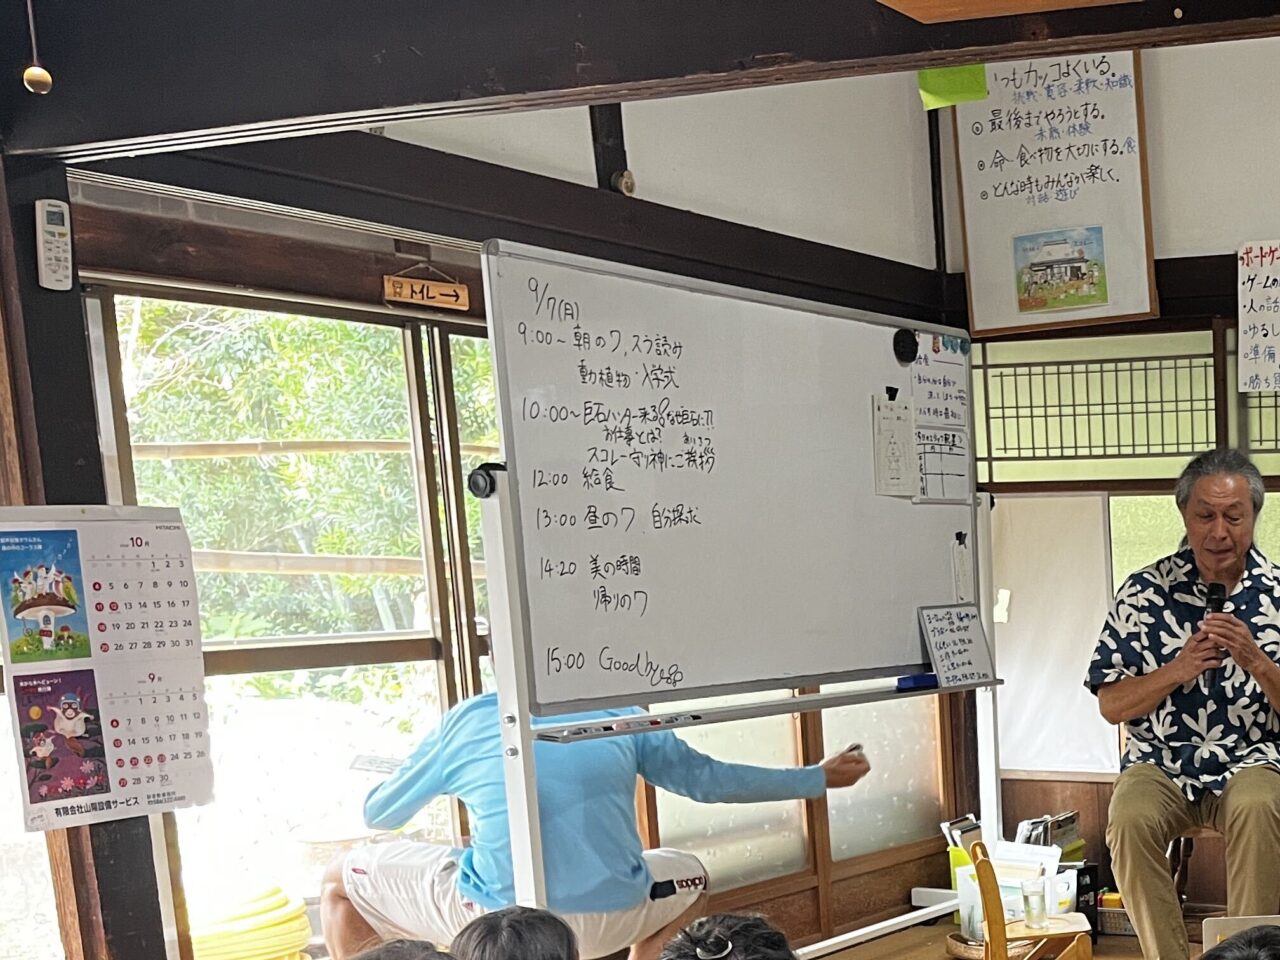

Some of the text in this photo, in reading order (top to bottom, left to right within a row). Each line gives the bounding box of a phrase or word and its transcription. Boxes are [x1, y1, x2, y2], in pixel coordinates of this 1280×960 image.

[410, 283, 437, 301] トイレ
[533, 467, 625, 491] 12:00 給食
[536, 506, 577, 530] 13:00
[179, 560, 185, 568] 3
[540, 554, 641, 579] 14:20 美の時間
[108, 582, 114, 590] 5
[123, 582, 129, 590] 6
[138, 581, 144, 589] 7
[152, 581, 159, 589] 8
[167, 580, 173, 588] 9
[180, 580, 189, 588] 10
[124, 602, 133, 610] 13
[139, 601, 148, 609] 14
[153, 601, 161, 609] 15
[167, 600, 176, 608] 16
[126, 622, 136, 630] 20
[141, 621, 149, 629] 21
[154, 621, 164, 629] 22
[169, 620, 178, 628] 23
[183, 619, 192, 627] 24
[114, 643, 124, 651] 26
[128, 642, 138, 650] 27
[142, 641, 152, 649] 28
[156, 640, 166, 648] 29
[171, 640, 180, 648] 30
[185, 639, 194, 647] 31
[547, 647, 585, 675] 15:00
[152, 696, 157, 704] 2
[166, 695, 171, 703] 3
[179, 694, 185, 702] 4
[192, 693, 198, 701] 5
[127, 718, 132, 726] 7
[141, 717, 146, 725] 8
[154, 715, 160, 723] 9
[166, 714, 175, 722] 10
[180, 713, 188, 721] 11
[193, 712, 201, 720] 12
[127, 738, 136, 746] 14
[141, 736, 150, 745] 15
[155, 735, 164, 743] 16
[168, 734, 177, 742] 17
[182, 732, 190, 740] 18
[194, 731, 203, 739] 19
[170, 752, 179, 761] 24
[183, 751, 192, 760] 25
[196, 750, 206, 758] 26
[132, 777, 142, 785] 28
[145, 775, 155, 784] 29
[159, 774, 169, 783] 30
